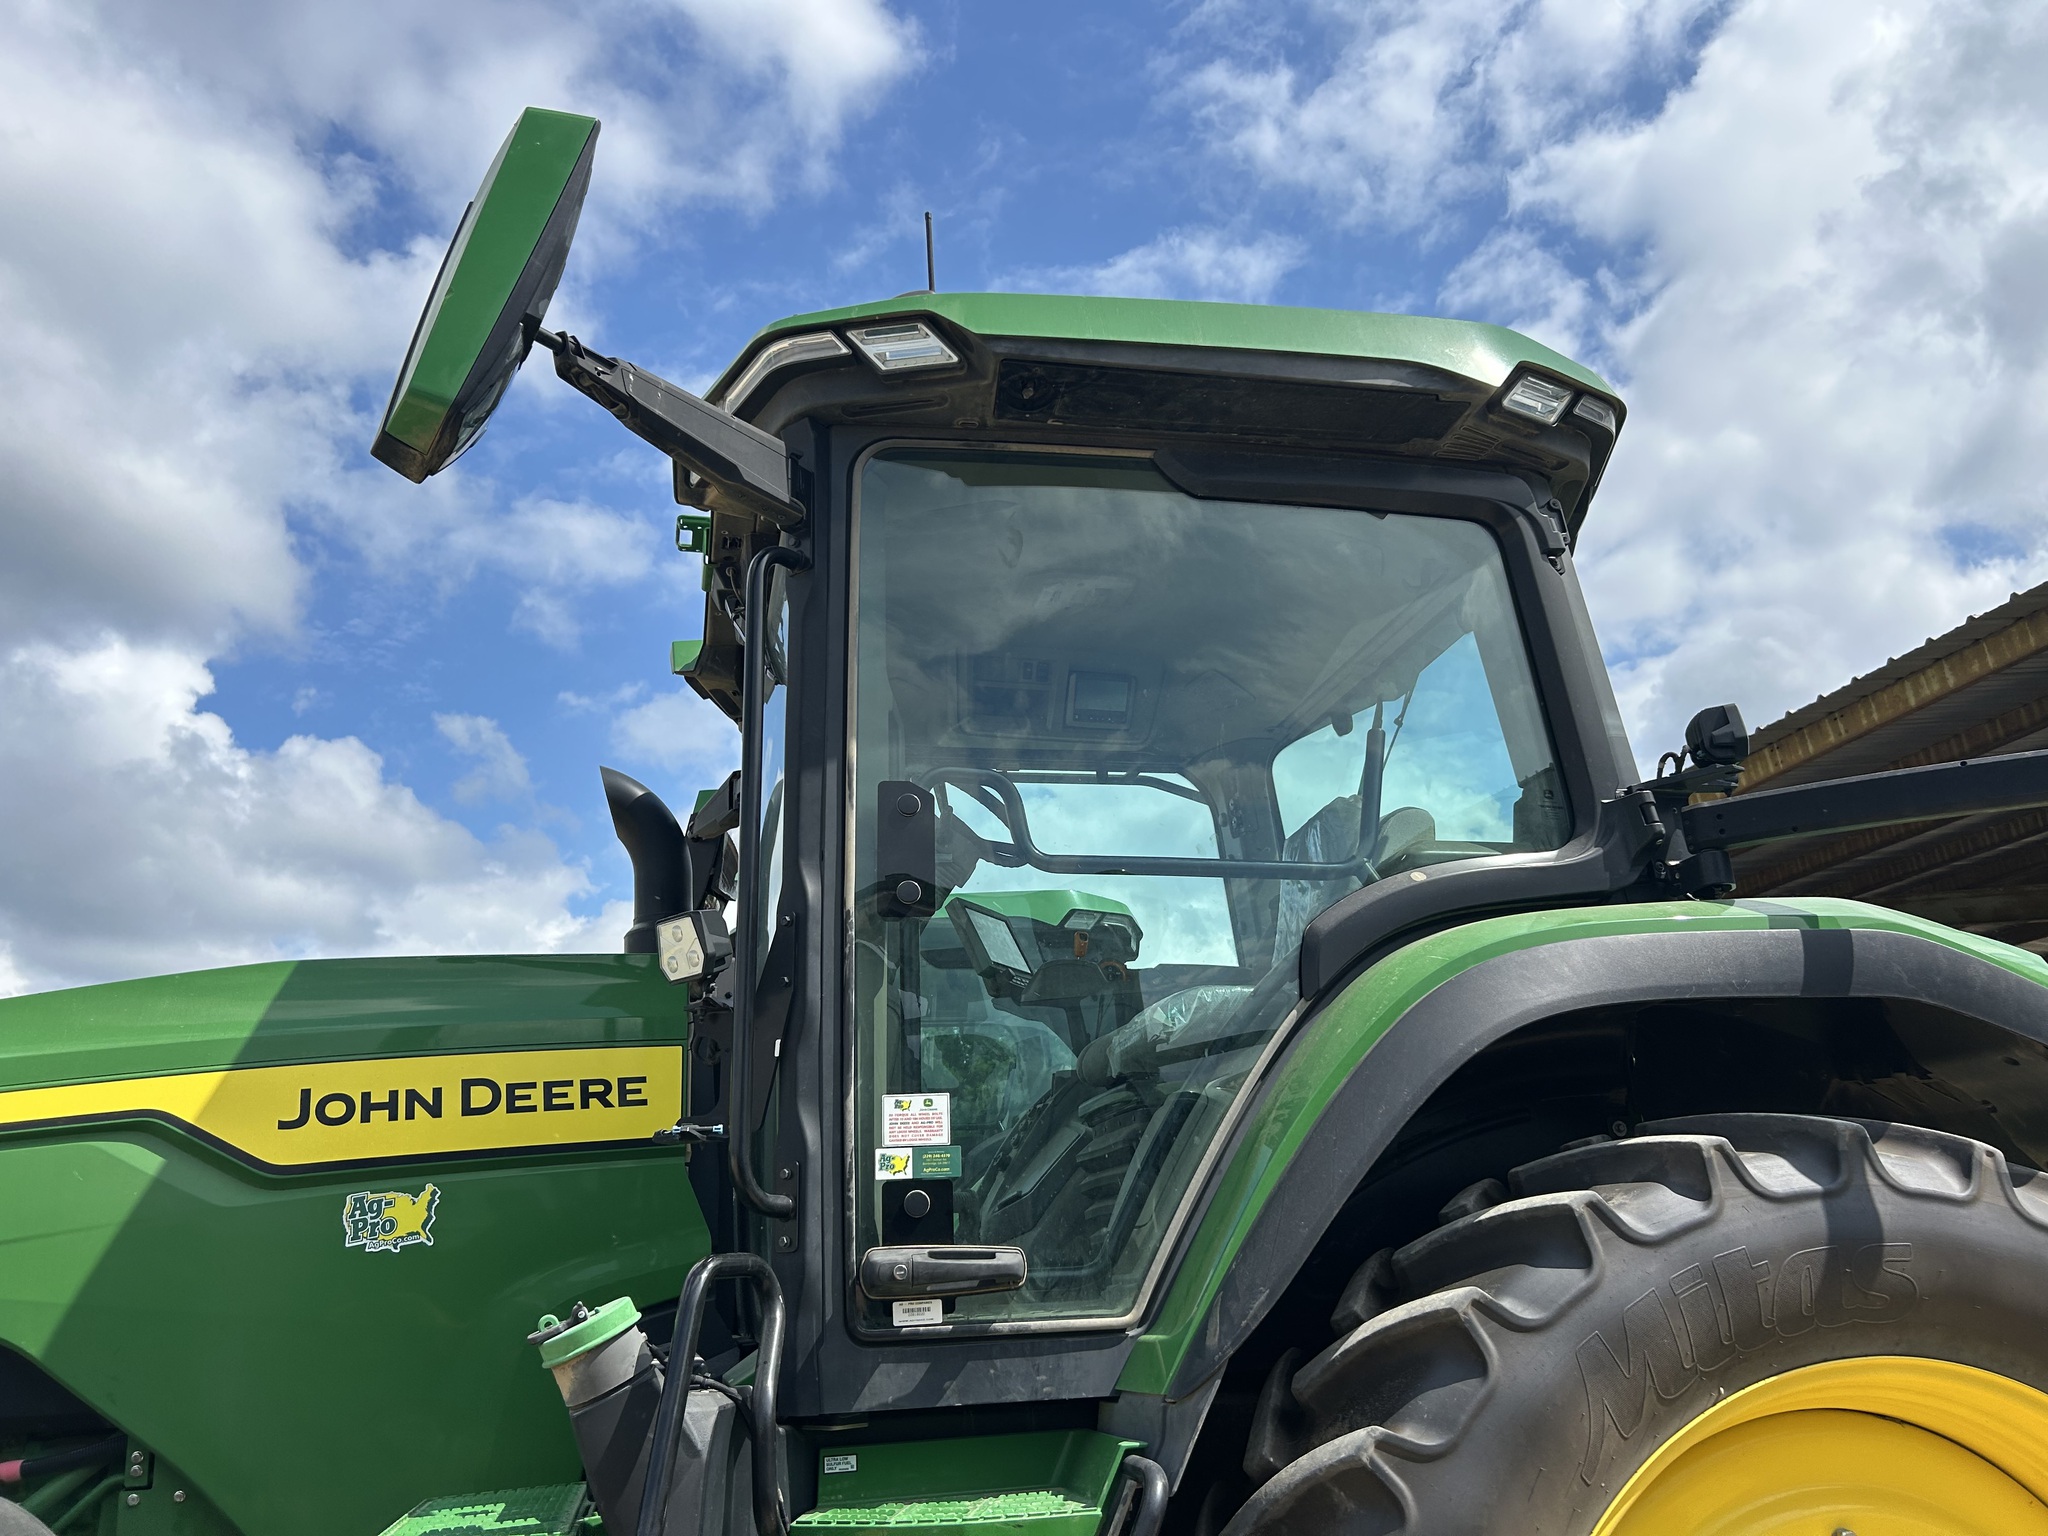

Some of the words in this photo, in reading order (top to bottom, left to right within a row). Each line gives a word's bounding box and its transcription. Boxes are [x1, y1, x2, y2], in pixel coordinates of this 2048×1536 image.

[277, 1087, 442, 1130] JOHN
[461, 1076, 648, 1117] DEERE
[879, 1162, 895, 1171] Pro
[349, 1194, 395, 1221] Ag-
[350, 1217, 397, 1241] Pro
[368, 1234, 420, 1249] AgProCo.com
[1575, 1242, 1919, 1486] Mitas
